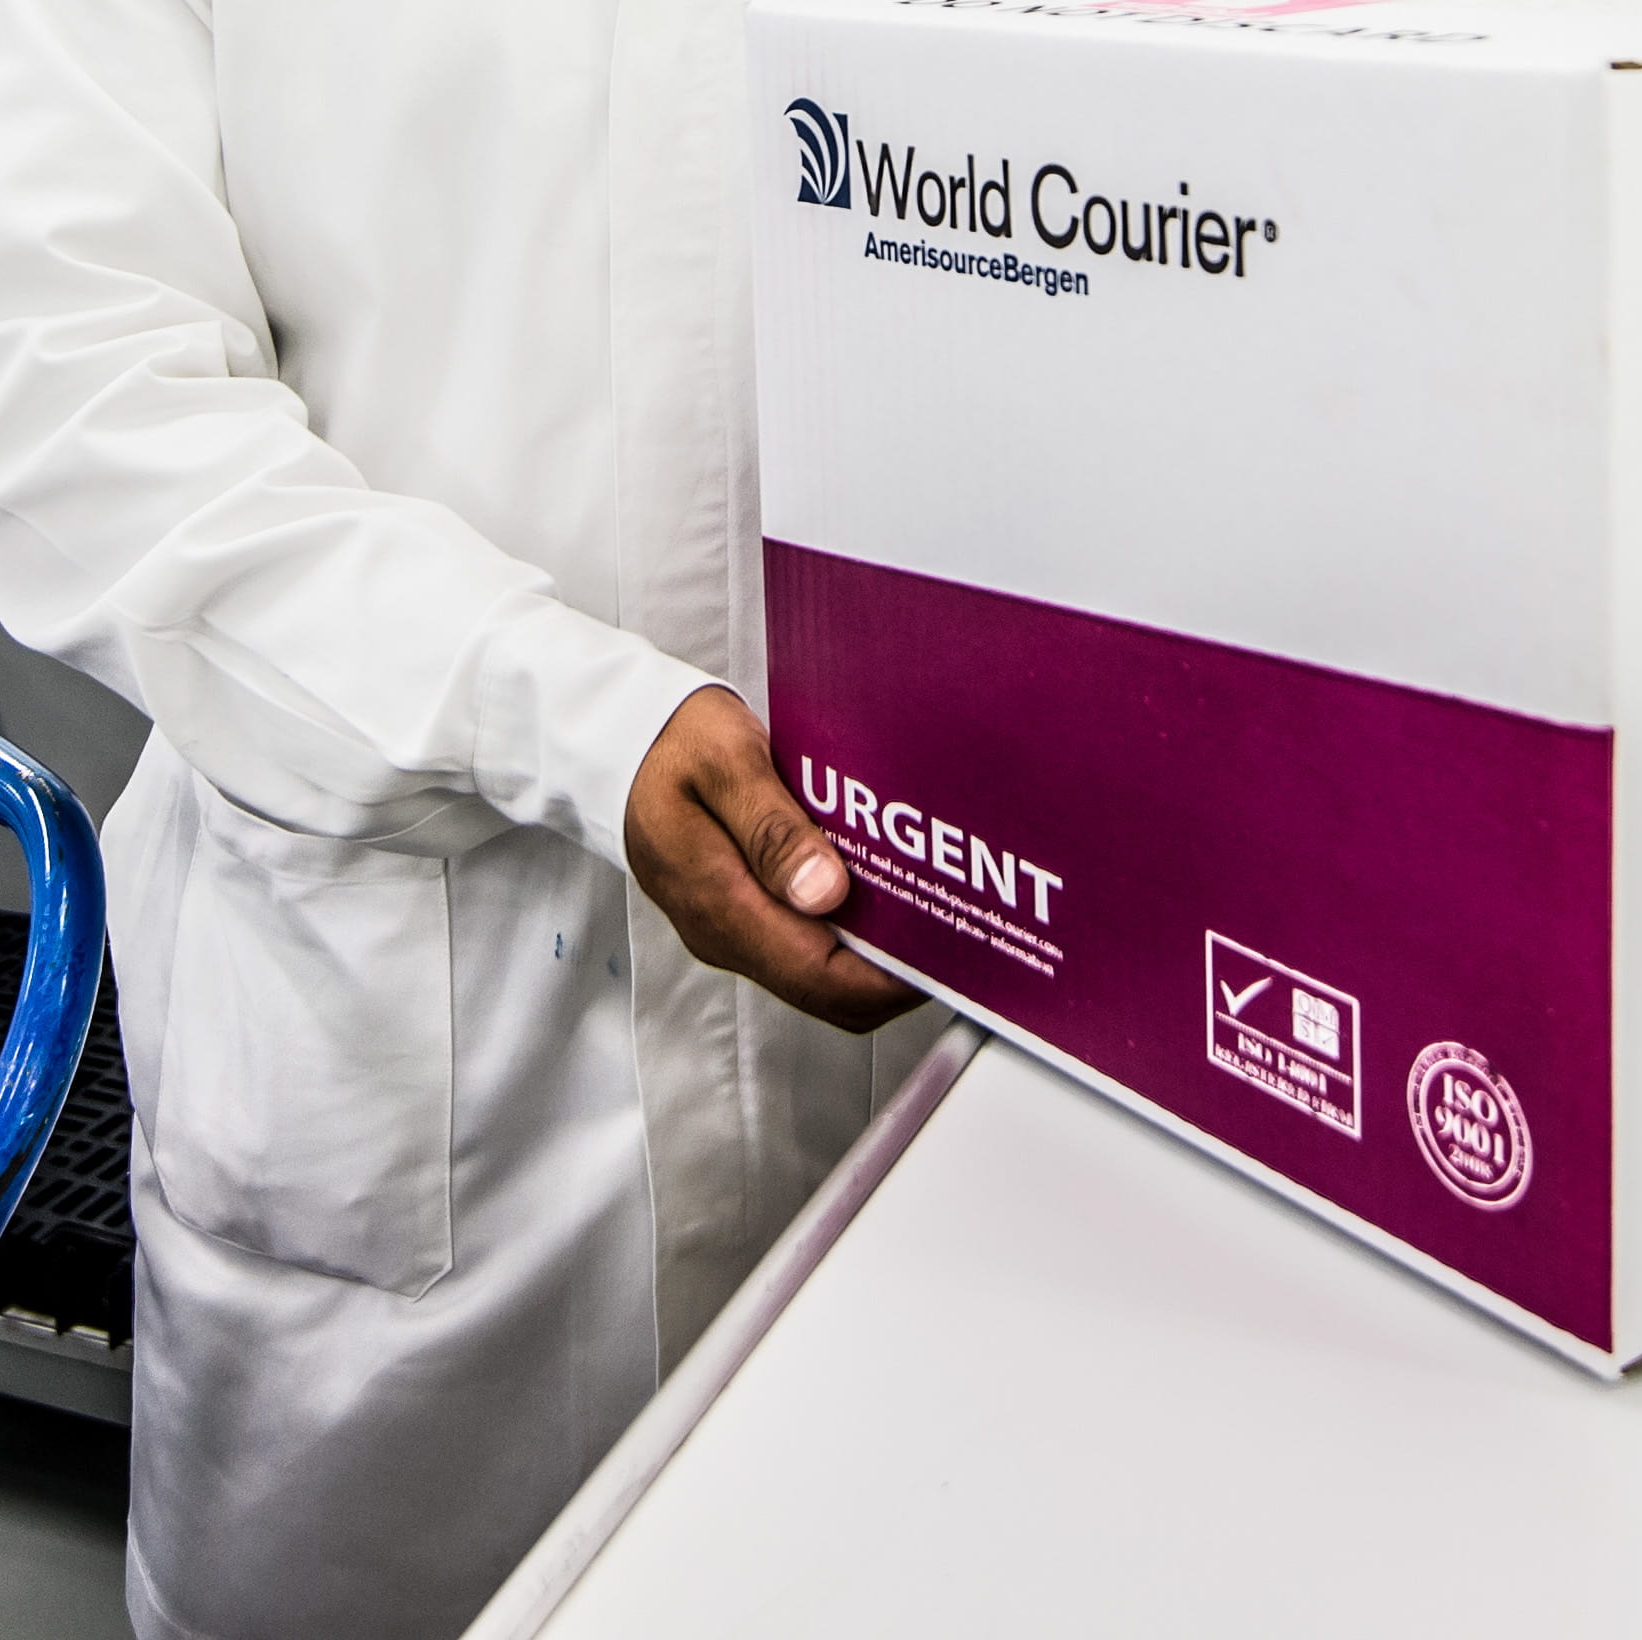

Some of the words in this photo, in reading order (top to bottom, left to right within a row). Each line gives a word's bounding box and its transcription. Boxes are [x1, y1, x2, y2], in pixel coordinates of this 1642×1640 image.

[856, 140, 1013, 240] World
[862, 231, 1090, 299] AmerisourceBergen
[801, 754, 1064, 926] URGENT
[1442, 1072, 1500, 1129] ISO
[1434, 1105, 1506, 1168] 9001
